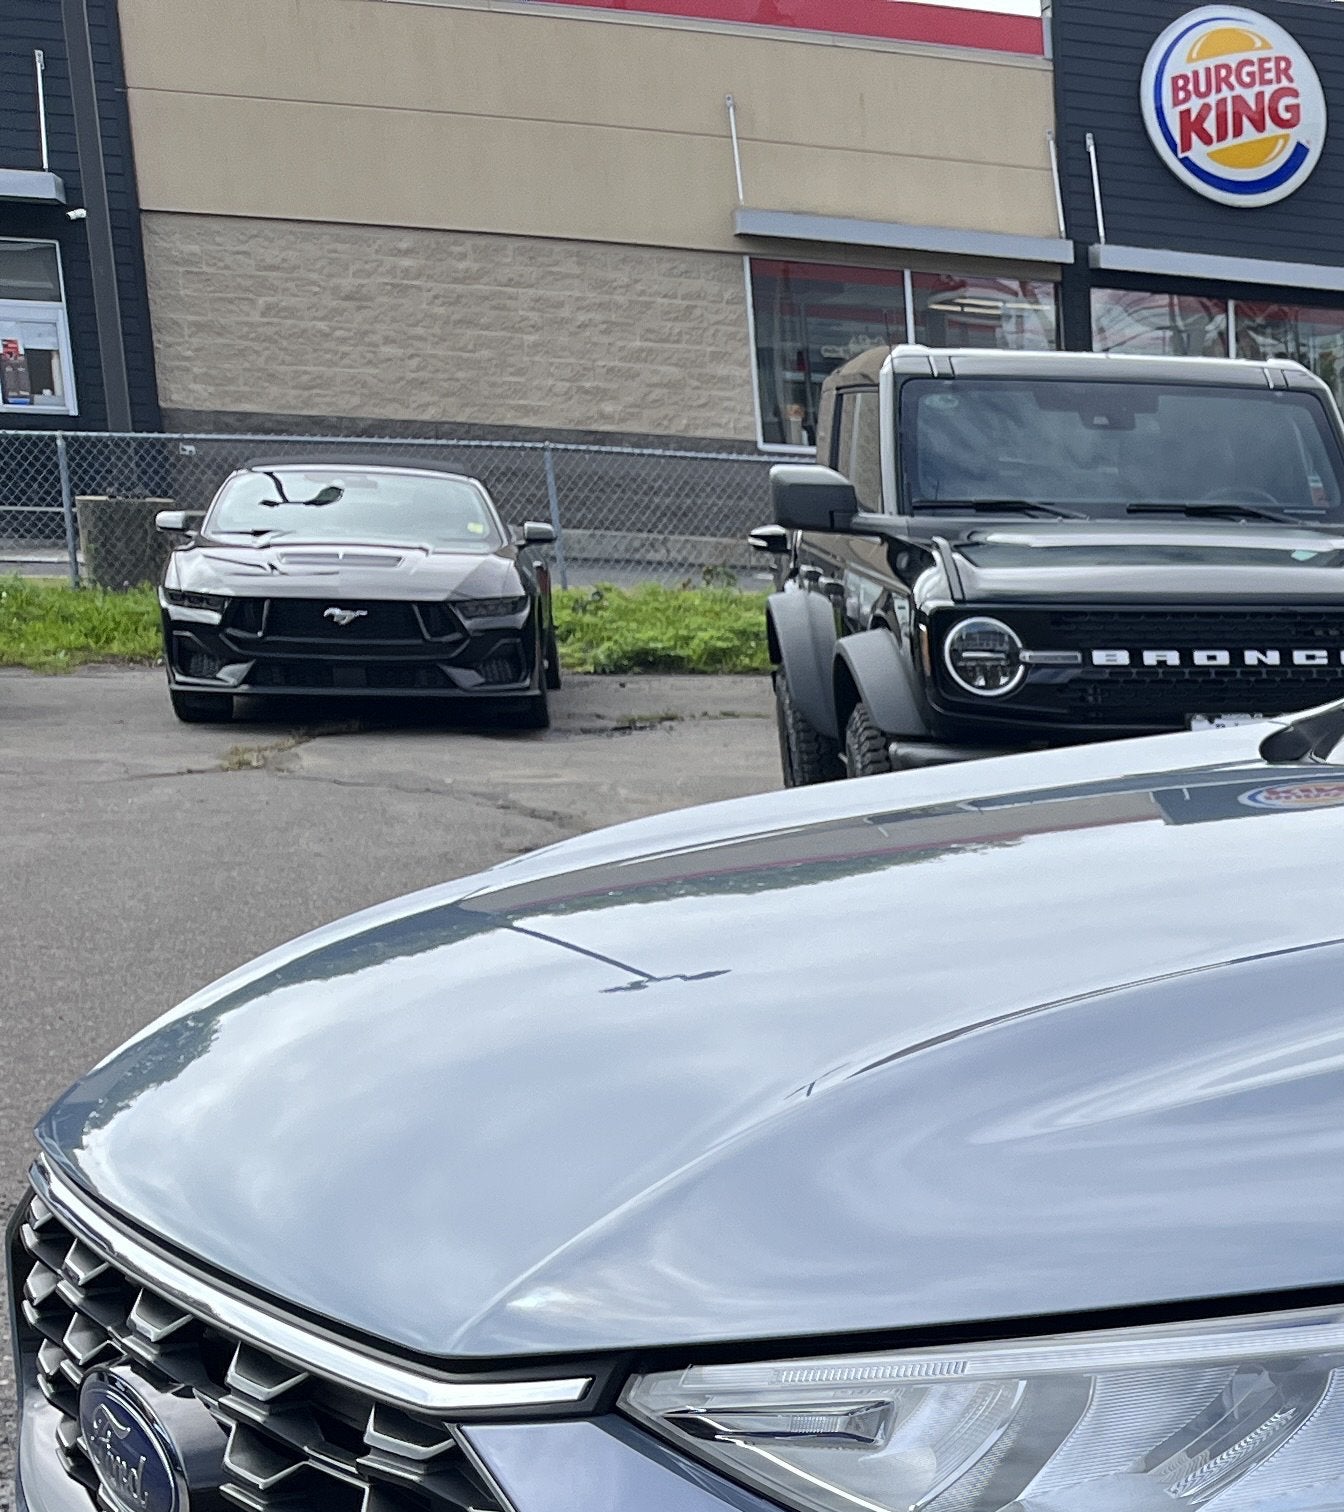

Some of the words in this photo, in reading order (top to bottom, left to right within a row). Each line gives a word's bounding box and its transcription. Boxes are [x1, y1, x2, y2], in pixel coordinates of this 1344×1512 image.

[1171, 56, 1294, 109] BURGER
[1179, 87, 1300, 154] KING
[90, 1403, 148, 1509] Ford
